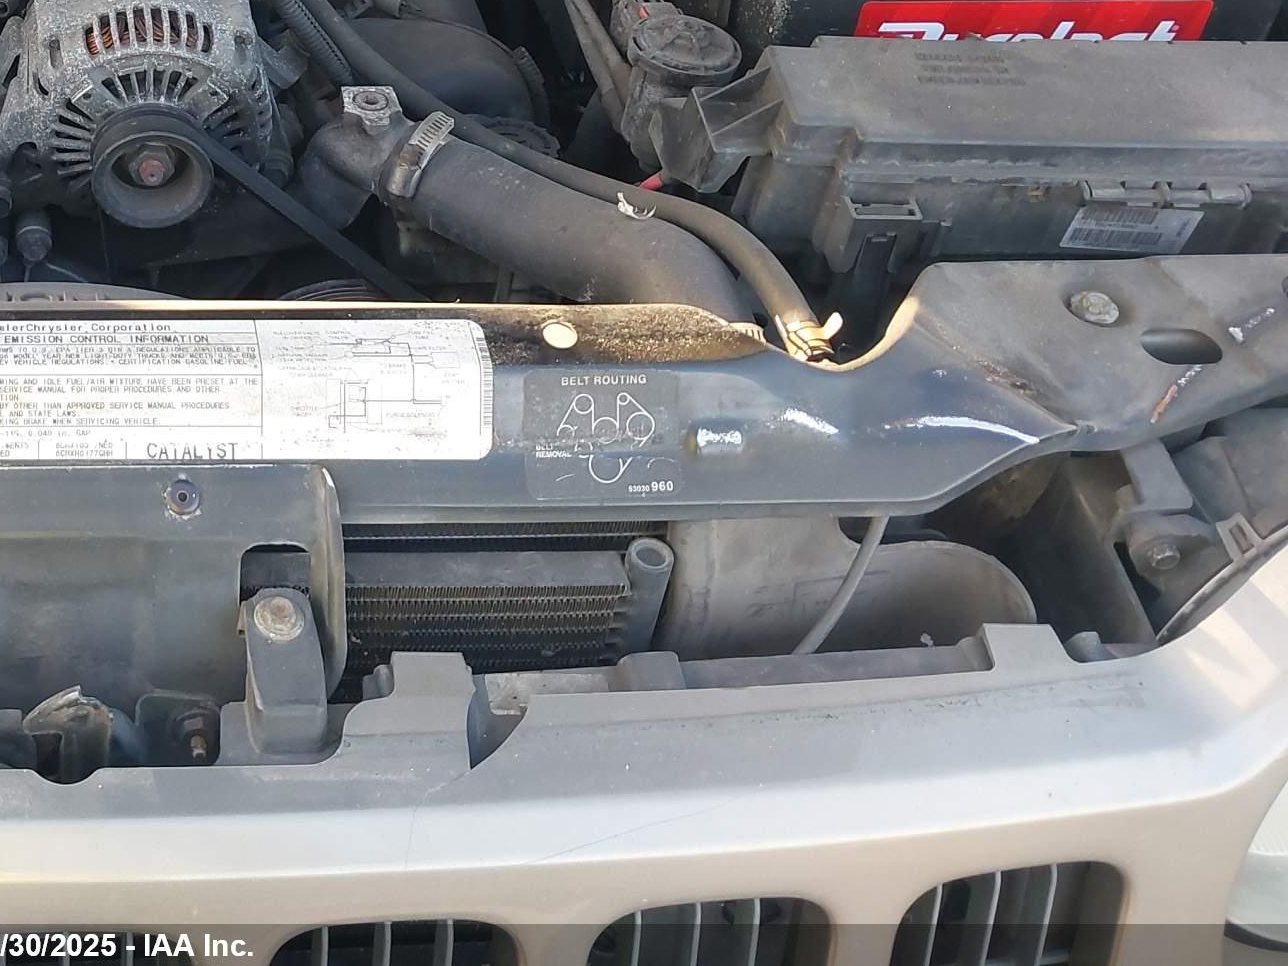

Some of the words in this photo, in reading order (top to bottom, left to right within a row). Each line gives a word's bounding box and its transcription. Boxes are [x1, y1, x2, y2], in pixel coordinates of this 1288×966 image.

[91, 323, 171, 333] Corporation
[4, 335, 63, 344] EMISSION
[69, 335, 121, 344] CONTROL
[130, 334, 209, 344] INFORMATION
[171, 377, 191, 385] BEEN
[195, 377, 224, 385] PRESET
[228, 377, 239, 385] AT
[243, 377, 258, 385] THE
[561, 376, 590, 386] BELT
[593, 374, 647, 385] ROUTING
[195, 385, 219, 393] OTHER
[146, 442, 238, 459] CATALYST
[535, 450, 571, 458] REMOVAL
[651, 480, 674, 491] 960
